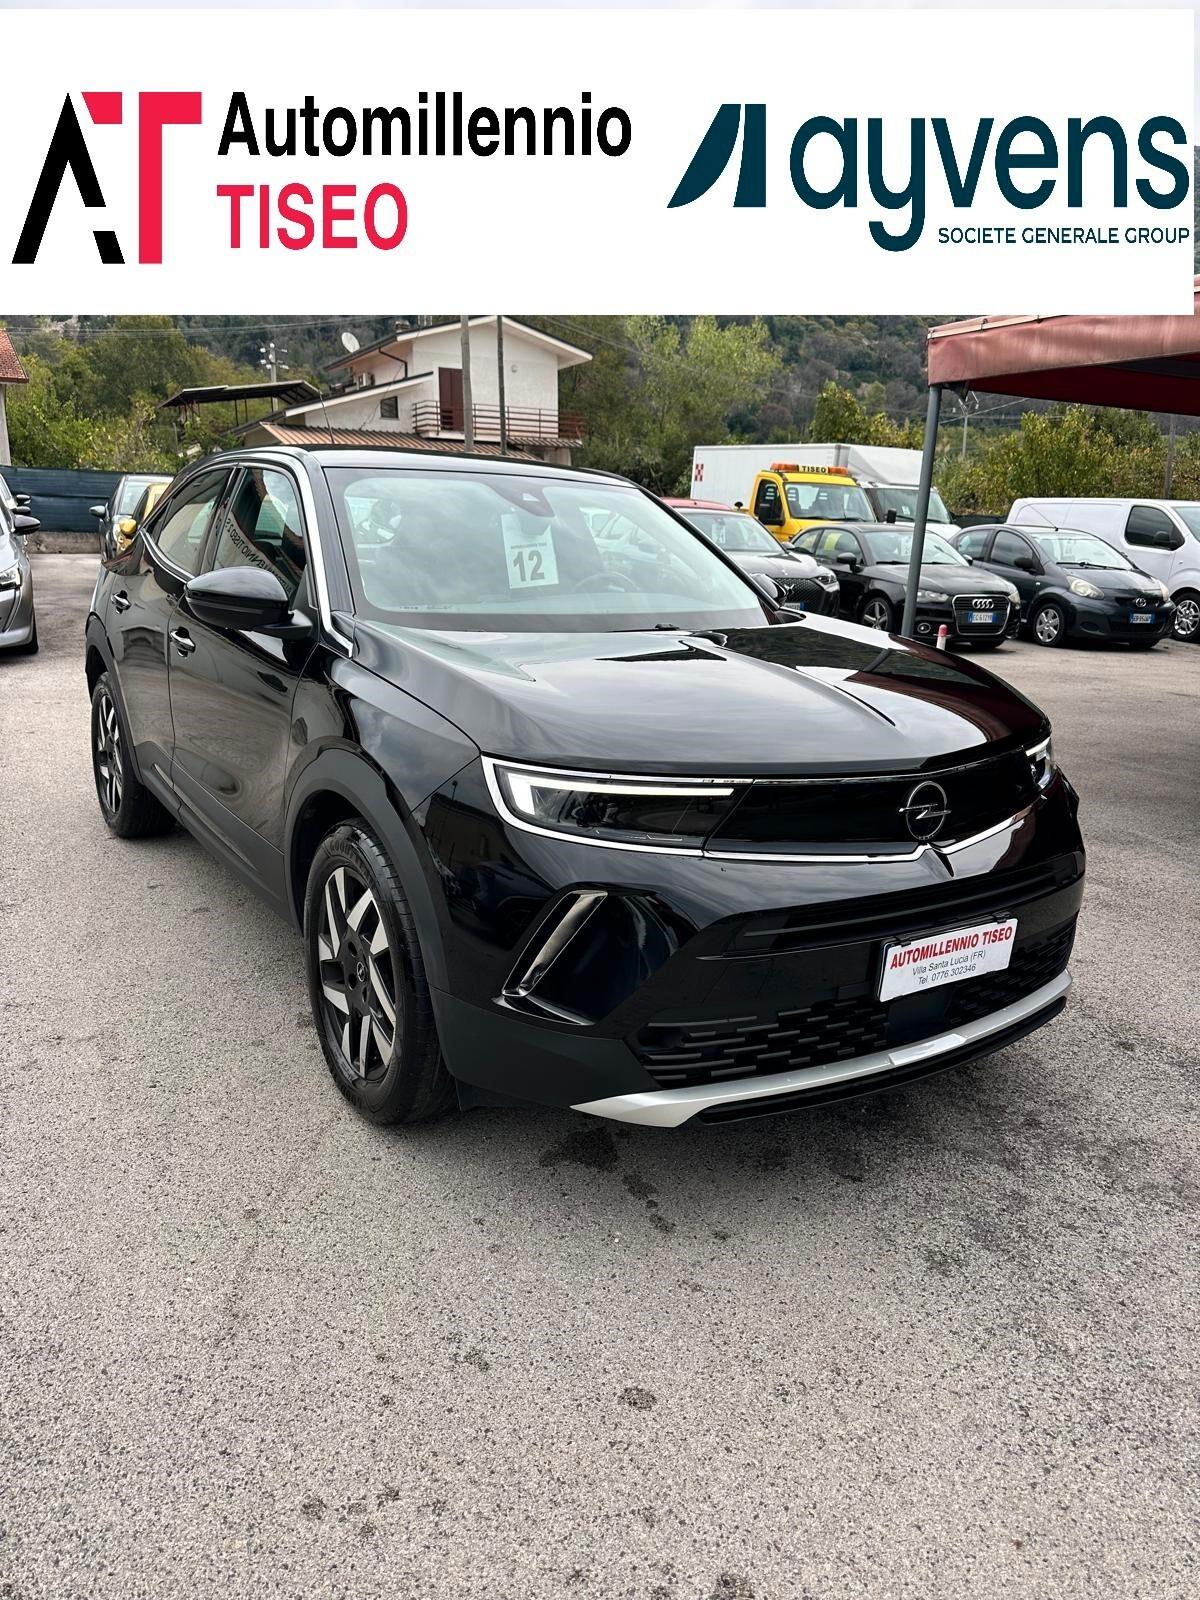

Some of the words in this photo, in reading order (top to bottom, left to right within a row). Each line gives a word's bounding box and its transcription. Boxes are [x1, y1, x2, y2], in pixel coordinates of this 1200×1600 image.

[801, 465, 827, 473] TISEO
[513, 550, 545, 582] 12
[890, 933, 979, 969] AUTOMILLENNIO
[982, 926, 1012, 945] TISEO
[912, 966, 927, 976] Villa
[929, 960, 948, 971] Santa
[950, 954, 968, 966] Lucia
[970, 949, 986, 963] (FR)
[919, 975, 930, 985] Tel.
